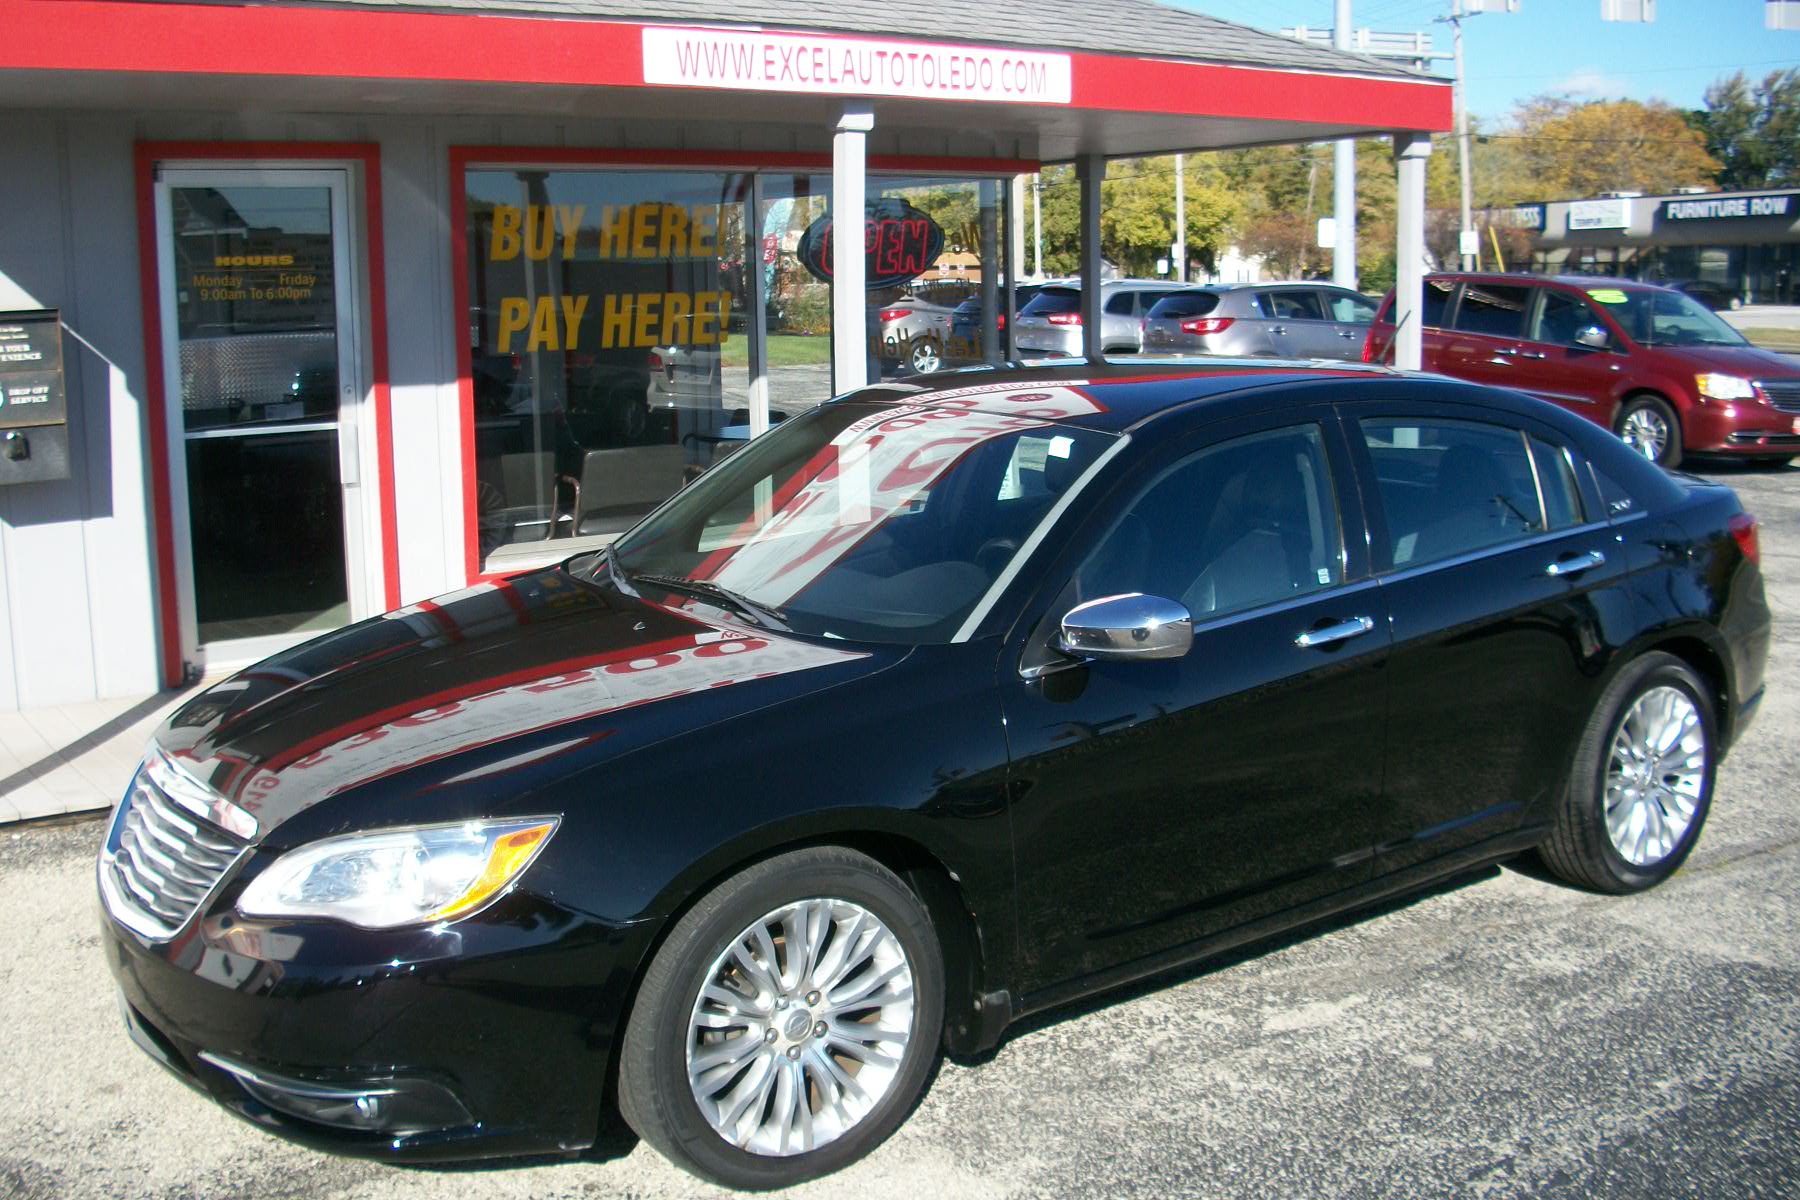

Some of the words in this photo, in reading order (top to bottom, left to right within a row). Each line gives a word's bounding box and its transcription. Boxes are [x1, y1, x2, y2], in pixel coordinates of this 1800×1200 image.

[676, 40, 1046, 94] WWW.EXCELAUTOTOLEDO.COM
[1667, 199, 1748, 219] FURNITURE
[1750, 198, 1788, 215] ROW
[490, 204, 587, 260] BUY
[600, 203, 730, 258] HERE!
[214, 255, 294, 266] HOURS
[193, 275, 242, 289] Monday
[279, 273, 316, 287] Friday
[249, 288, 263, 299] To
[497, 296, 589, 353] PAY
[601, 291, 732, 348] HERE!
